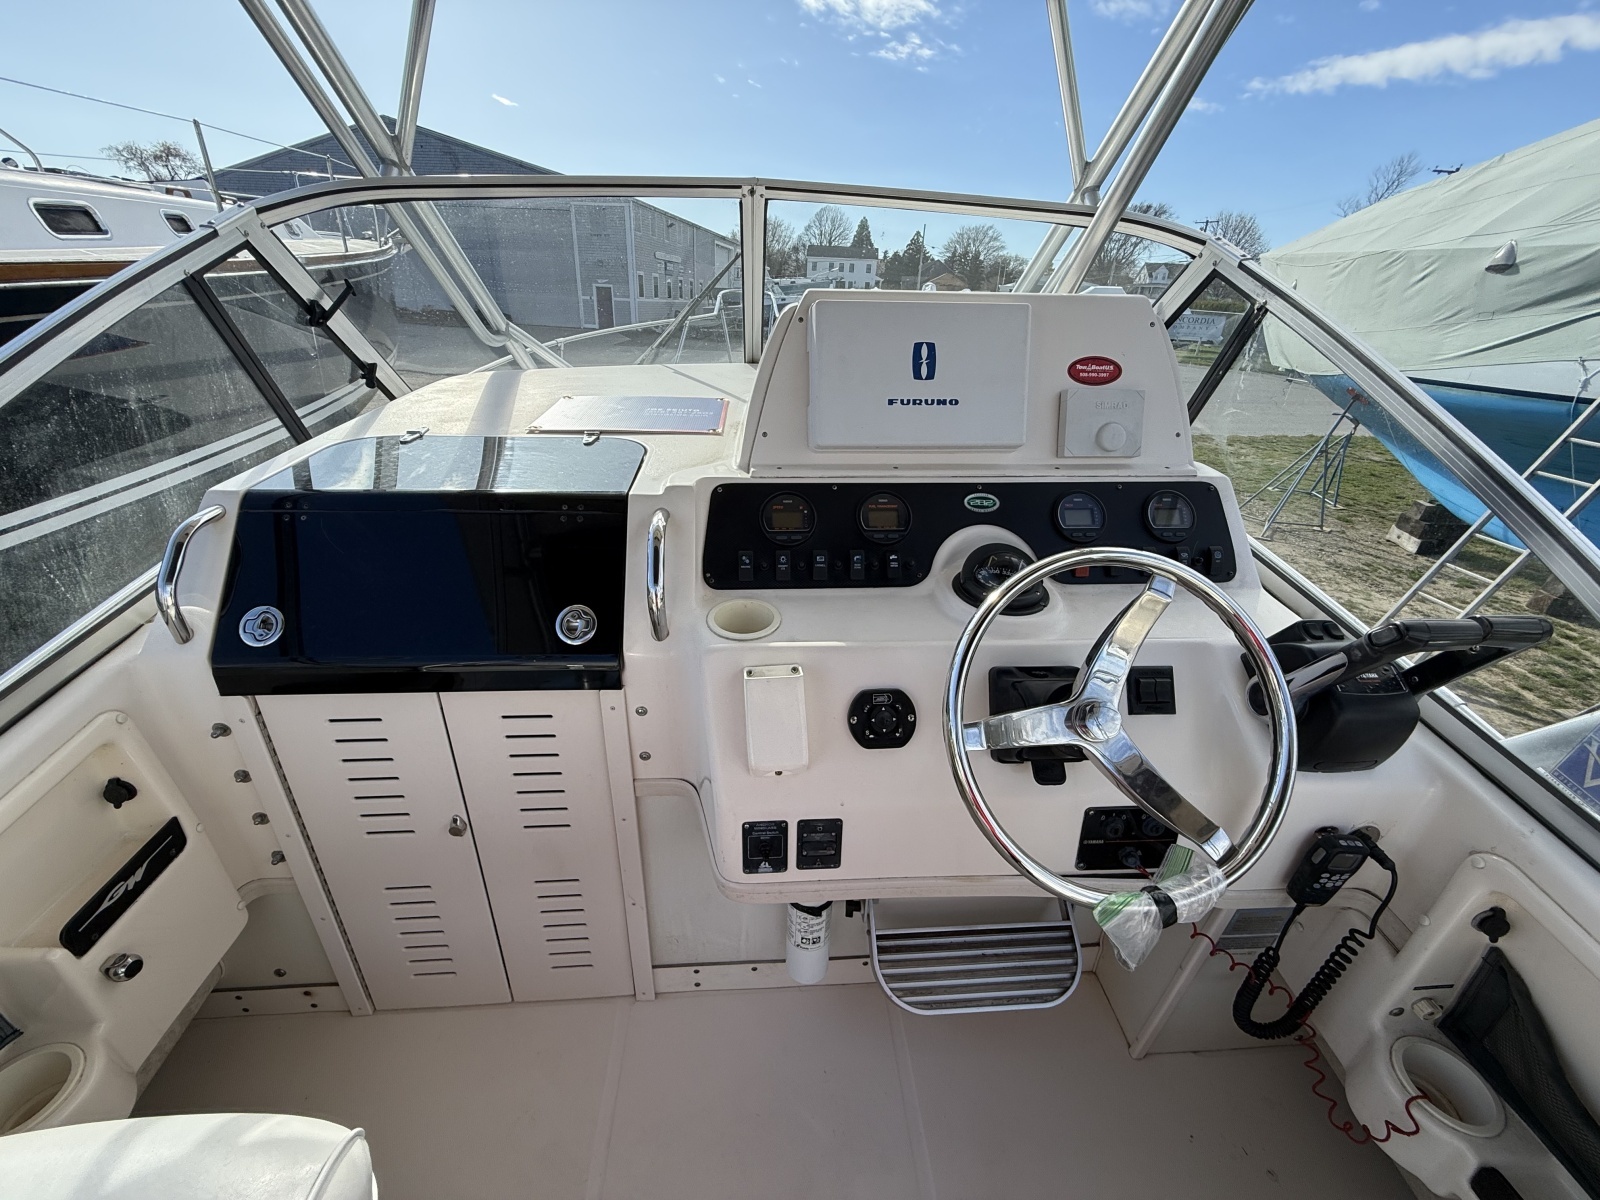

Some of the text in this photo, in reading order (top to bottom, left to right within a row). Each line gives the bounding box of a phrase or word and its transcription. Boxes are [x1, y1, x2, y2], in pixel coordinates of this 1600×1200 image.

[1178, 316, 1216, 325] NCORDIA
[887, 398, 960, 406] FURUNO
[1095, 401, 1128, 410] SIMRAD
[969, 498, 995, 507] 282
